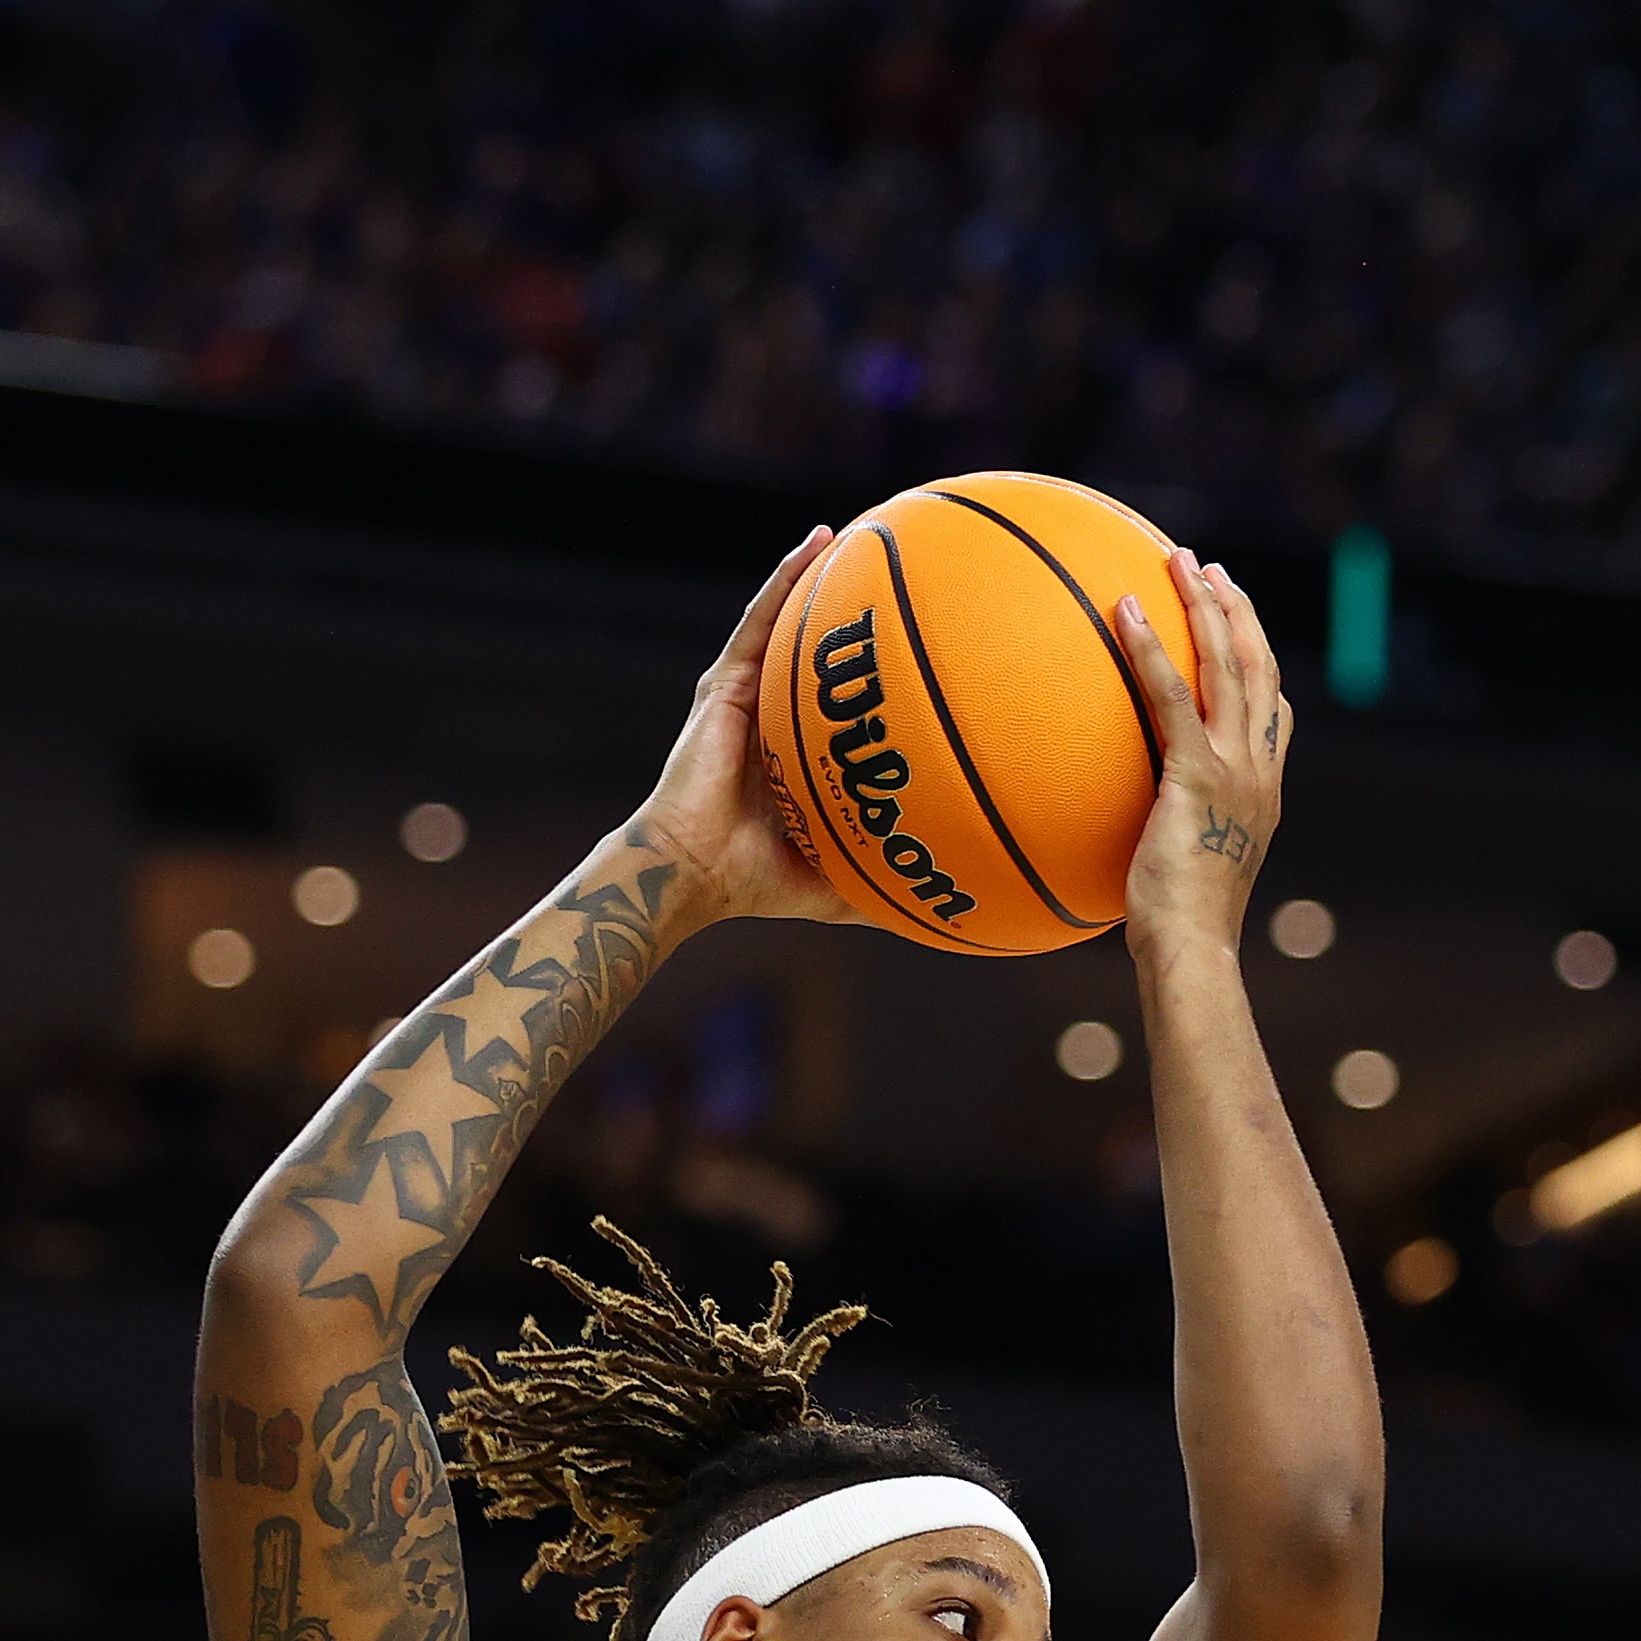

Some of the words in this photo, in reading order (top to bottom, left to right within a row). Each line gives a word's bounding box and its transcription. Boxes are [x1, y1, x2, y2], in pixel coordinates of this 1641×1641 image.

[812, 606, 978, 923] Wilson
[818, 756, 842, 800] EVO
[840, 806, 869, 848] NXT
